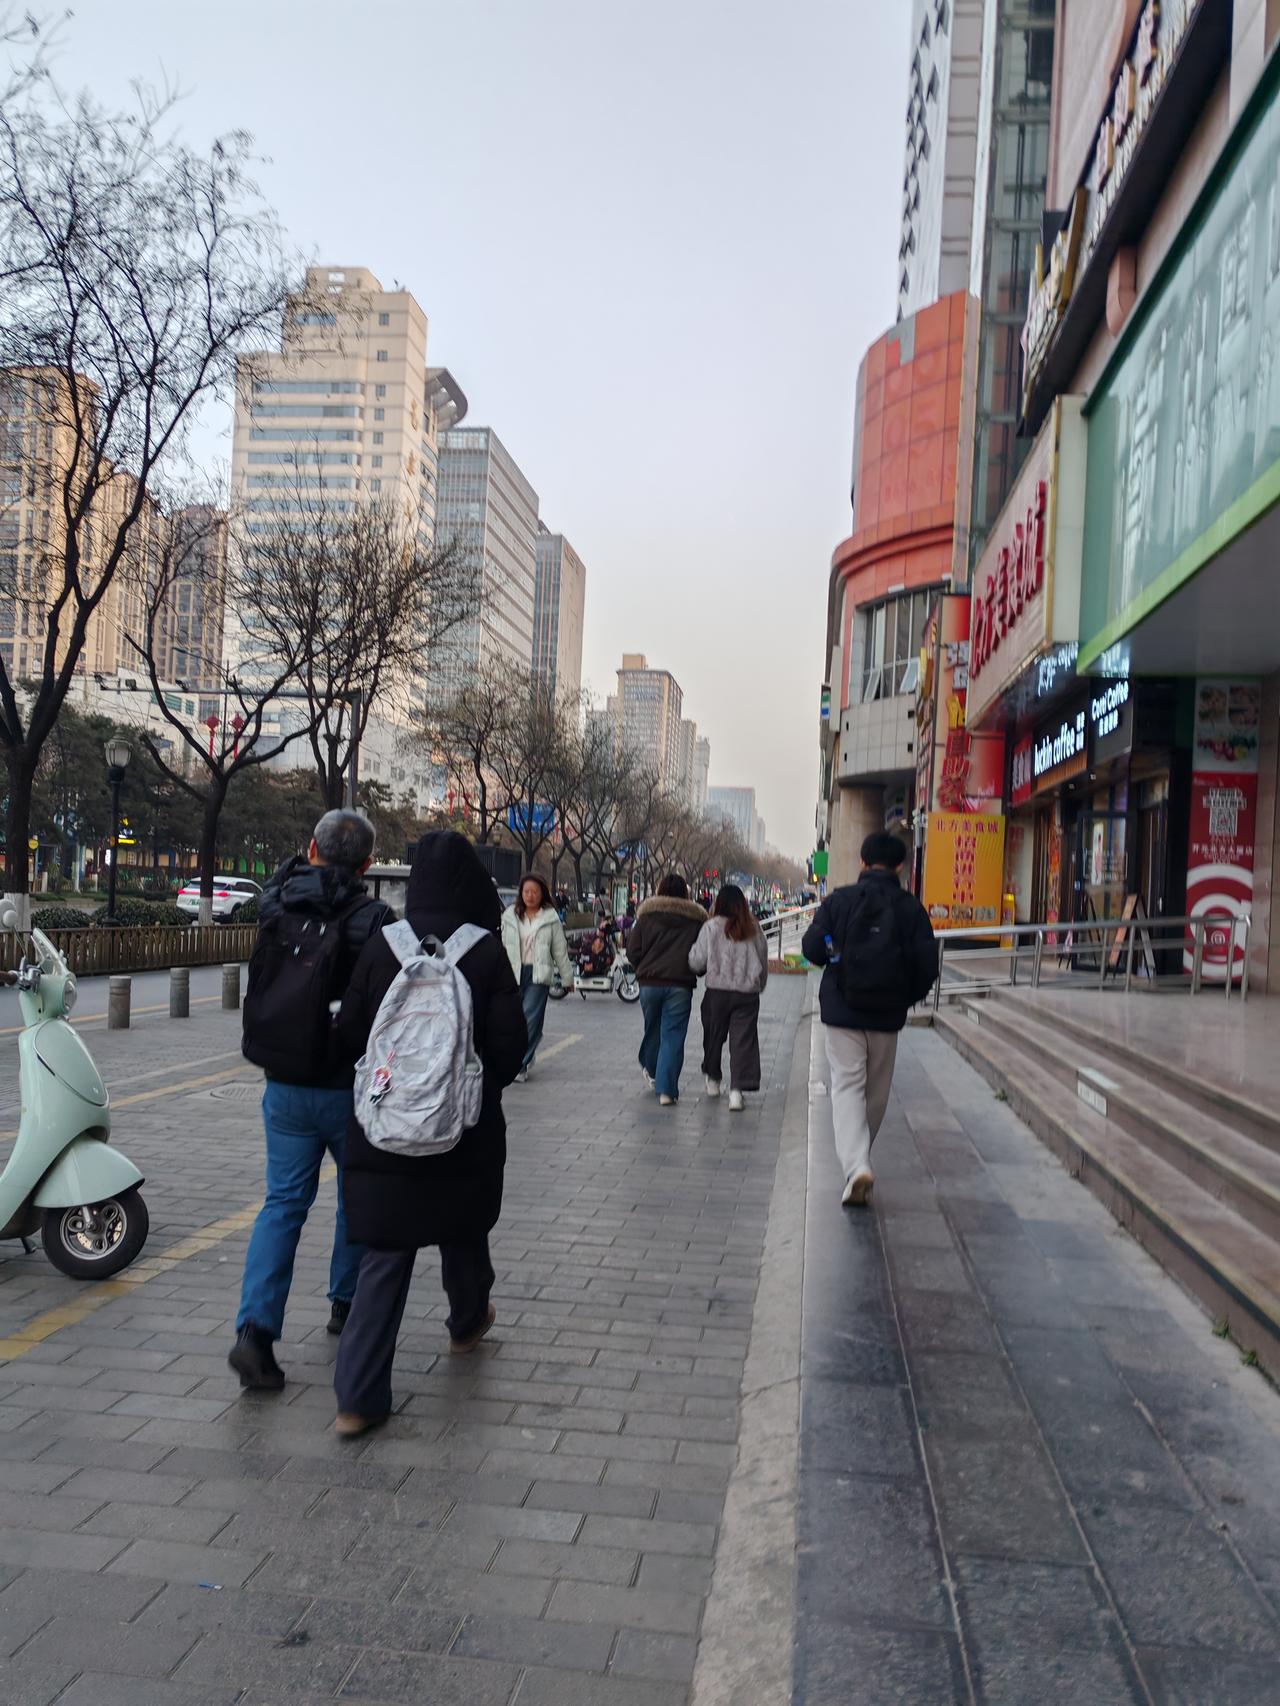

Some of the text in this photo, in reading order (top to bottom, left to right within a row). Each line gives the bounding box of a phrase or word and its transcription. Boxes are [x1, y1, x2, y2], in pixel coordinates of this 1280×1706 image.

[1107, 680, 1129, 711] Coffee
[1034, 735, 1053, 776] luckin
[1053, 722, 1075, 765] coffee
